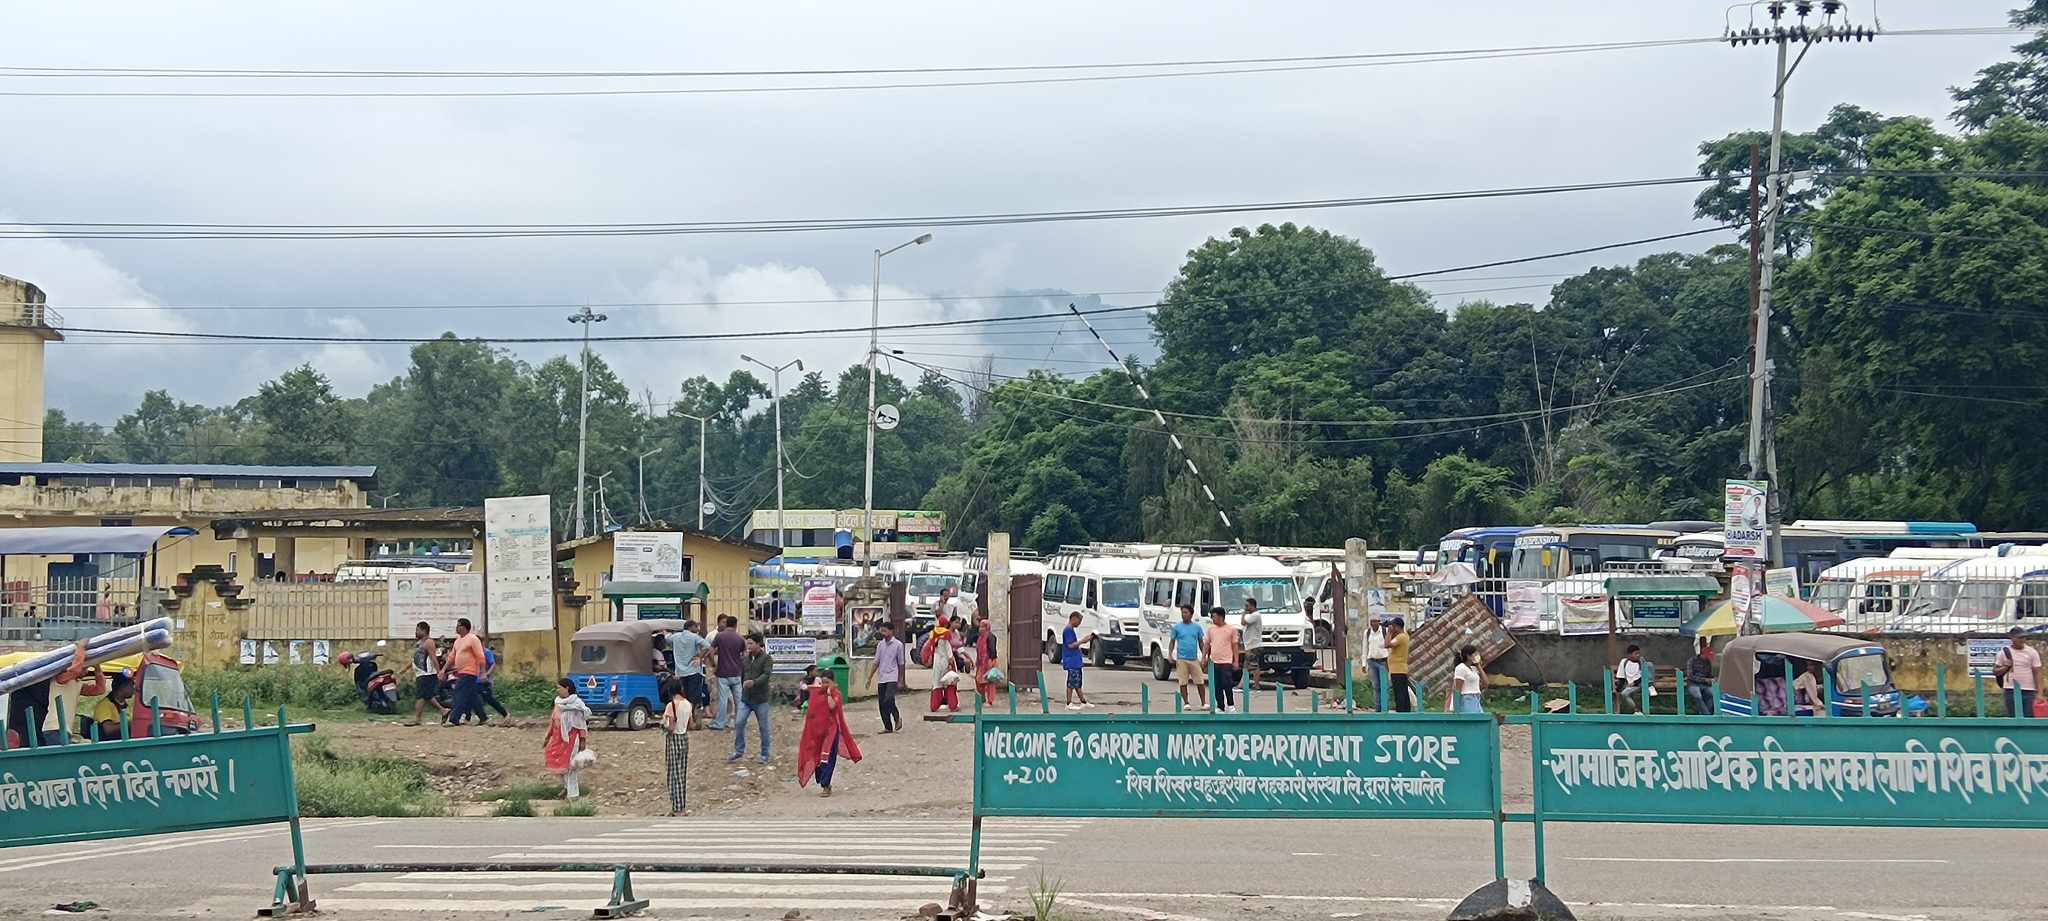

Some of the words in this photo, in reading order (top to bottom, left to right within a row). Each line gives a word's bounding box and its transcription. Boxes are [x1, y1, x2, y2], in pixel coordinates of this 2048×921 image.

[984, 726, 1057, 763] WELCOME
[1063, 730, 1084, 759] TO
[1088, 732, 1158, 766] GARDEN
[1374, 735, 1460, 770] STORE
[1936, 736, 1994, 805] शिव
[0, 771, 27, 812] ढी
[28, 776, 78, 810] भाडा
[78, 763, 122, 811] लिने
[122, 757, 161, 809] दिने
[1125, 766, 1151, 800] शिव
